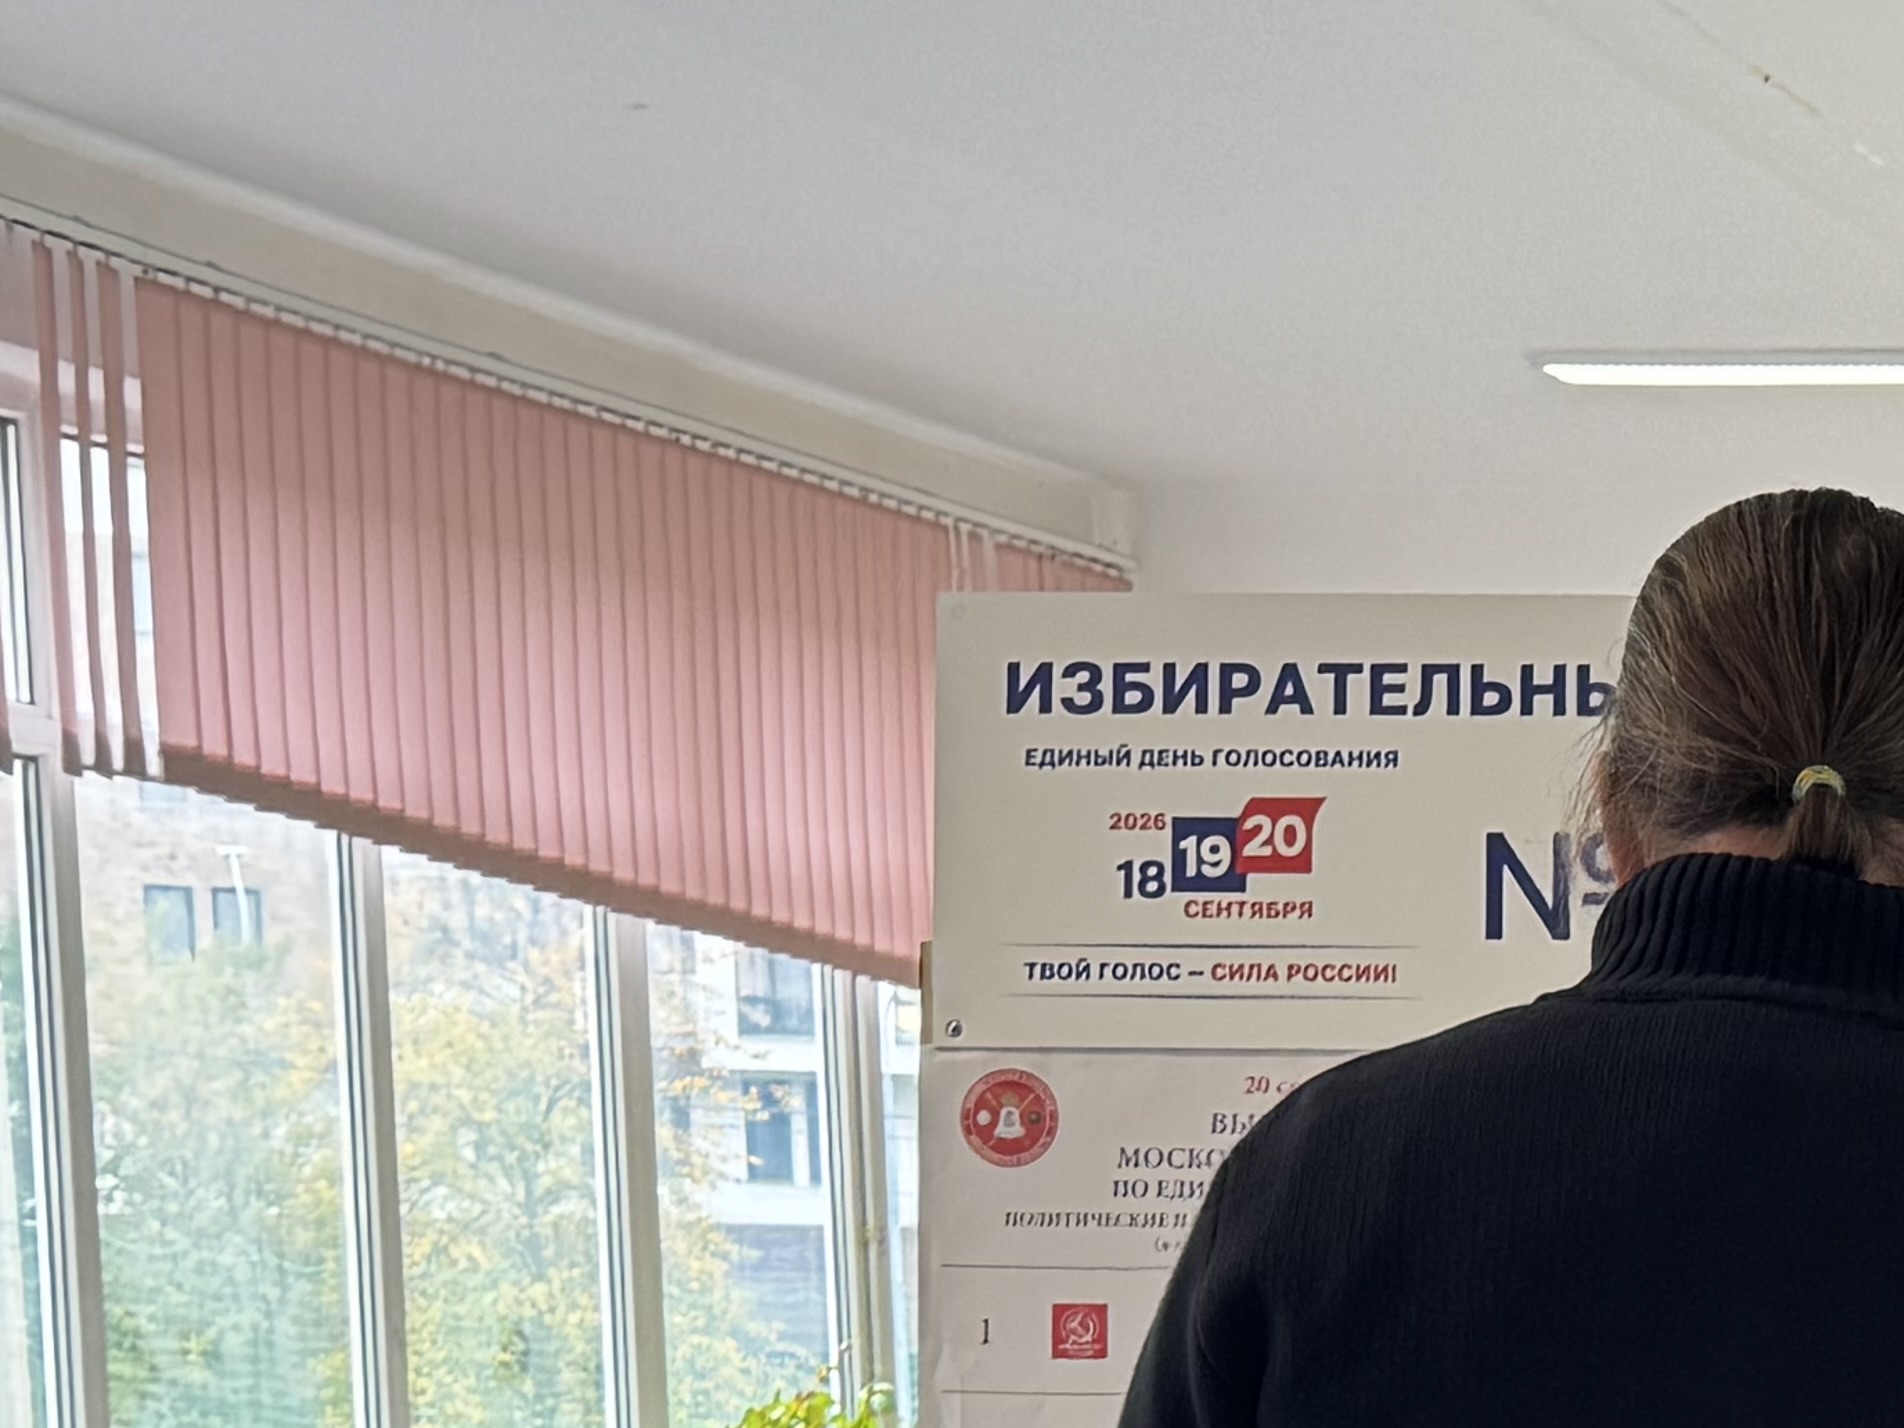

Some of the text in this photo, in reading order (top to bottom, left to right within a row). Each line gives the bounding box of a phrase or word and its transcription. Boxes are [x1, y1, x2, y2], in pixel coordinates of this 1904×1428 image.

[1005, 661, 1618, 718] ИЗБИРАТЕЛЬНЫ
[1024, 743, 1398, 772] ЕДИНЫЙ ДЕНЬ ГОЛОСОВАНИЯ
[1108, 809, 1166, 832] 2026
[1116, 814, 1306, 898] 18 19 20
[1184, 897, 1314, 922] СЕНТЯБРЯ
[1024, 959, 1090, 982] ТВОЙ
[1098, 961, 1180, 982] ГОЛОС
[1210, 961, 1276, 984] СИЛА
[1286, 962, 1397, 985] РОССИИ!
[1244, 1075, 1271, 1095] 20
[1113, 1178, 1148, 1198] ПО
[1005, 1211, 1168, 1228] ПОЛИТИЧЕСКИЕ
